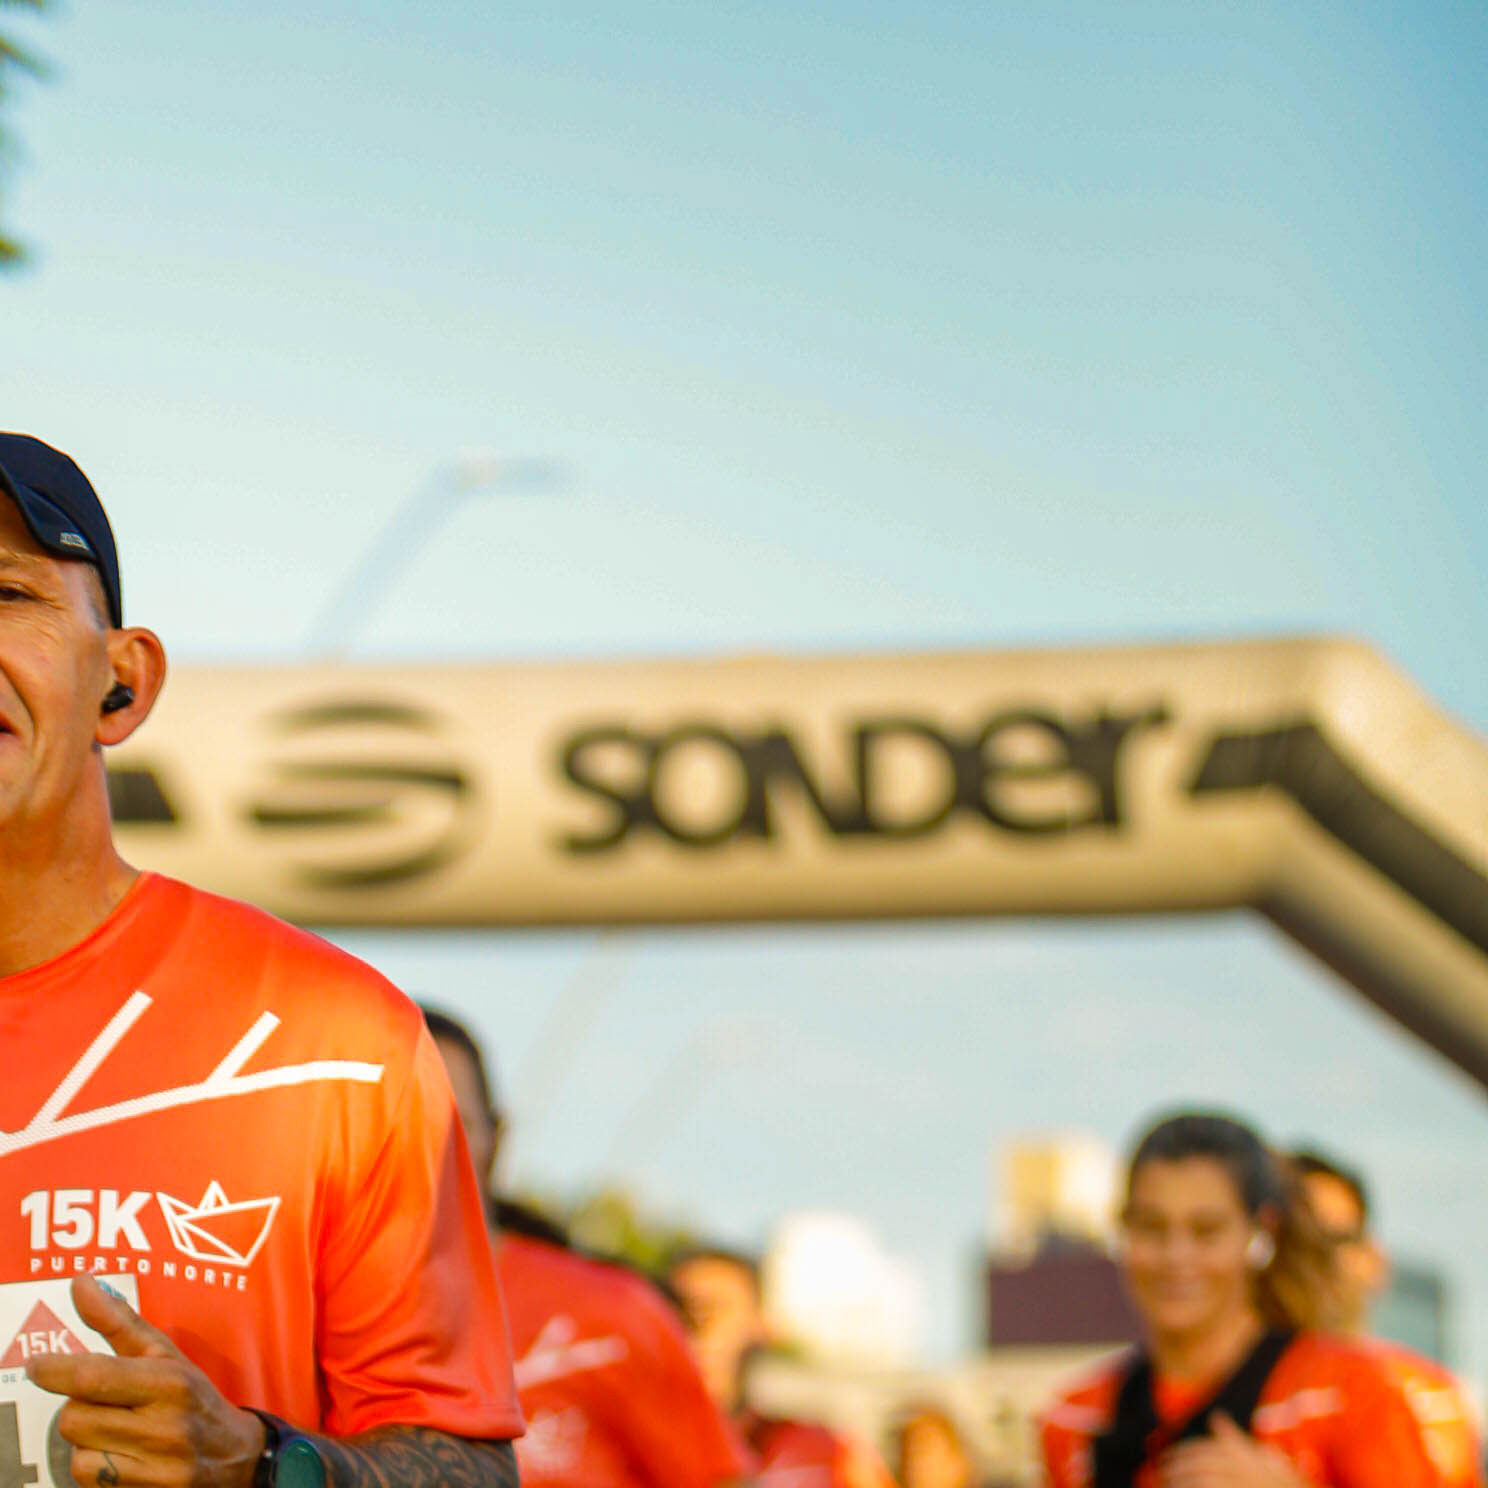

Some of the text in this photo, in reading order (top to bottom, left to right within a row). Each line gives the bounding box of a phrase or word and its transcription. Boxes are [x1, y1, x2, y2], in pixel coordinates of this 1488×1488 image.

[20, 1188, 153, 1252] 15K
[29, 1255, 249, 1291] PUERTO NORTE
[15, 1328, 73, 1358] 15K
